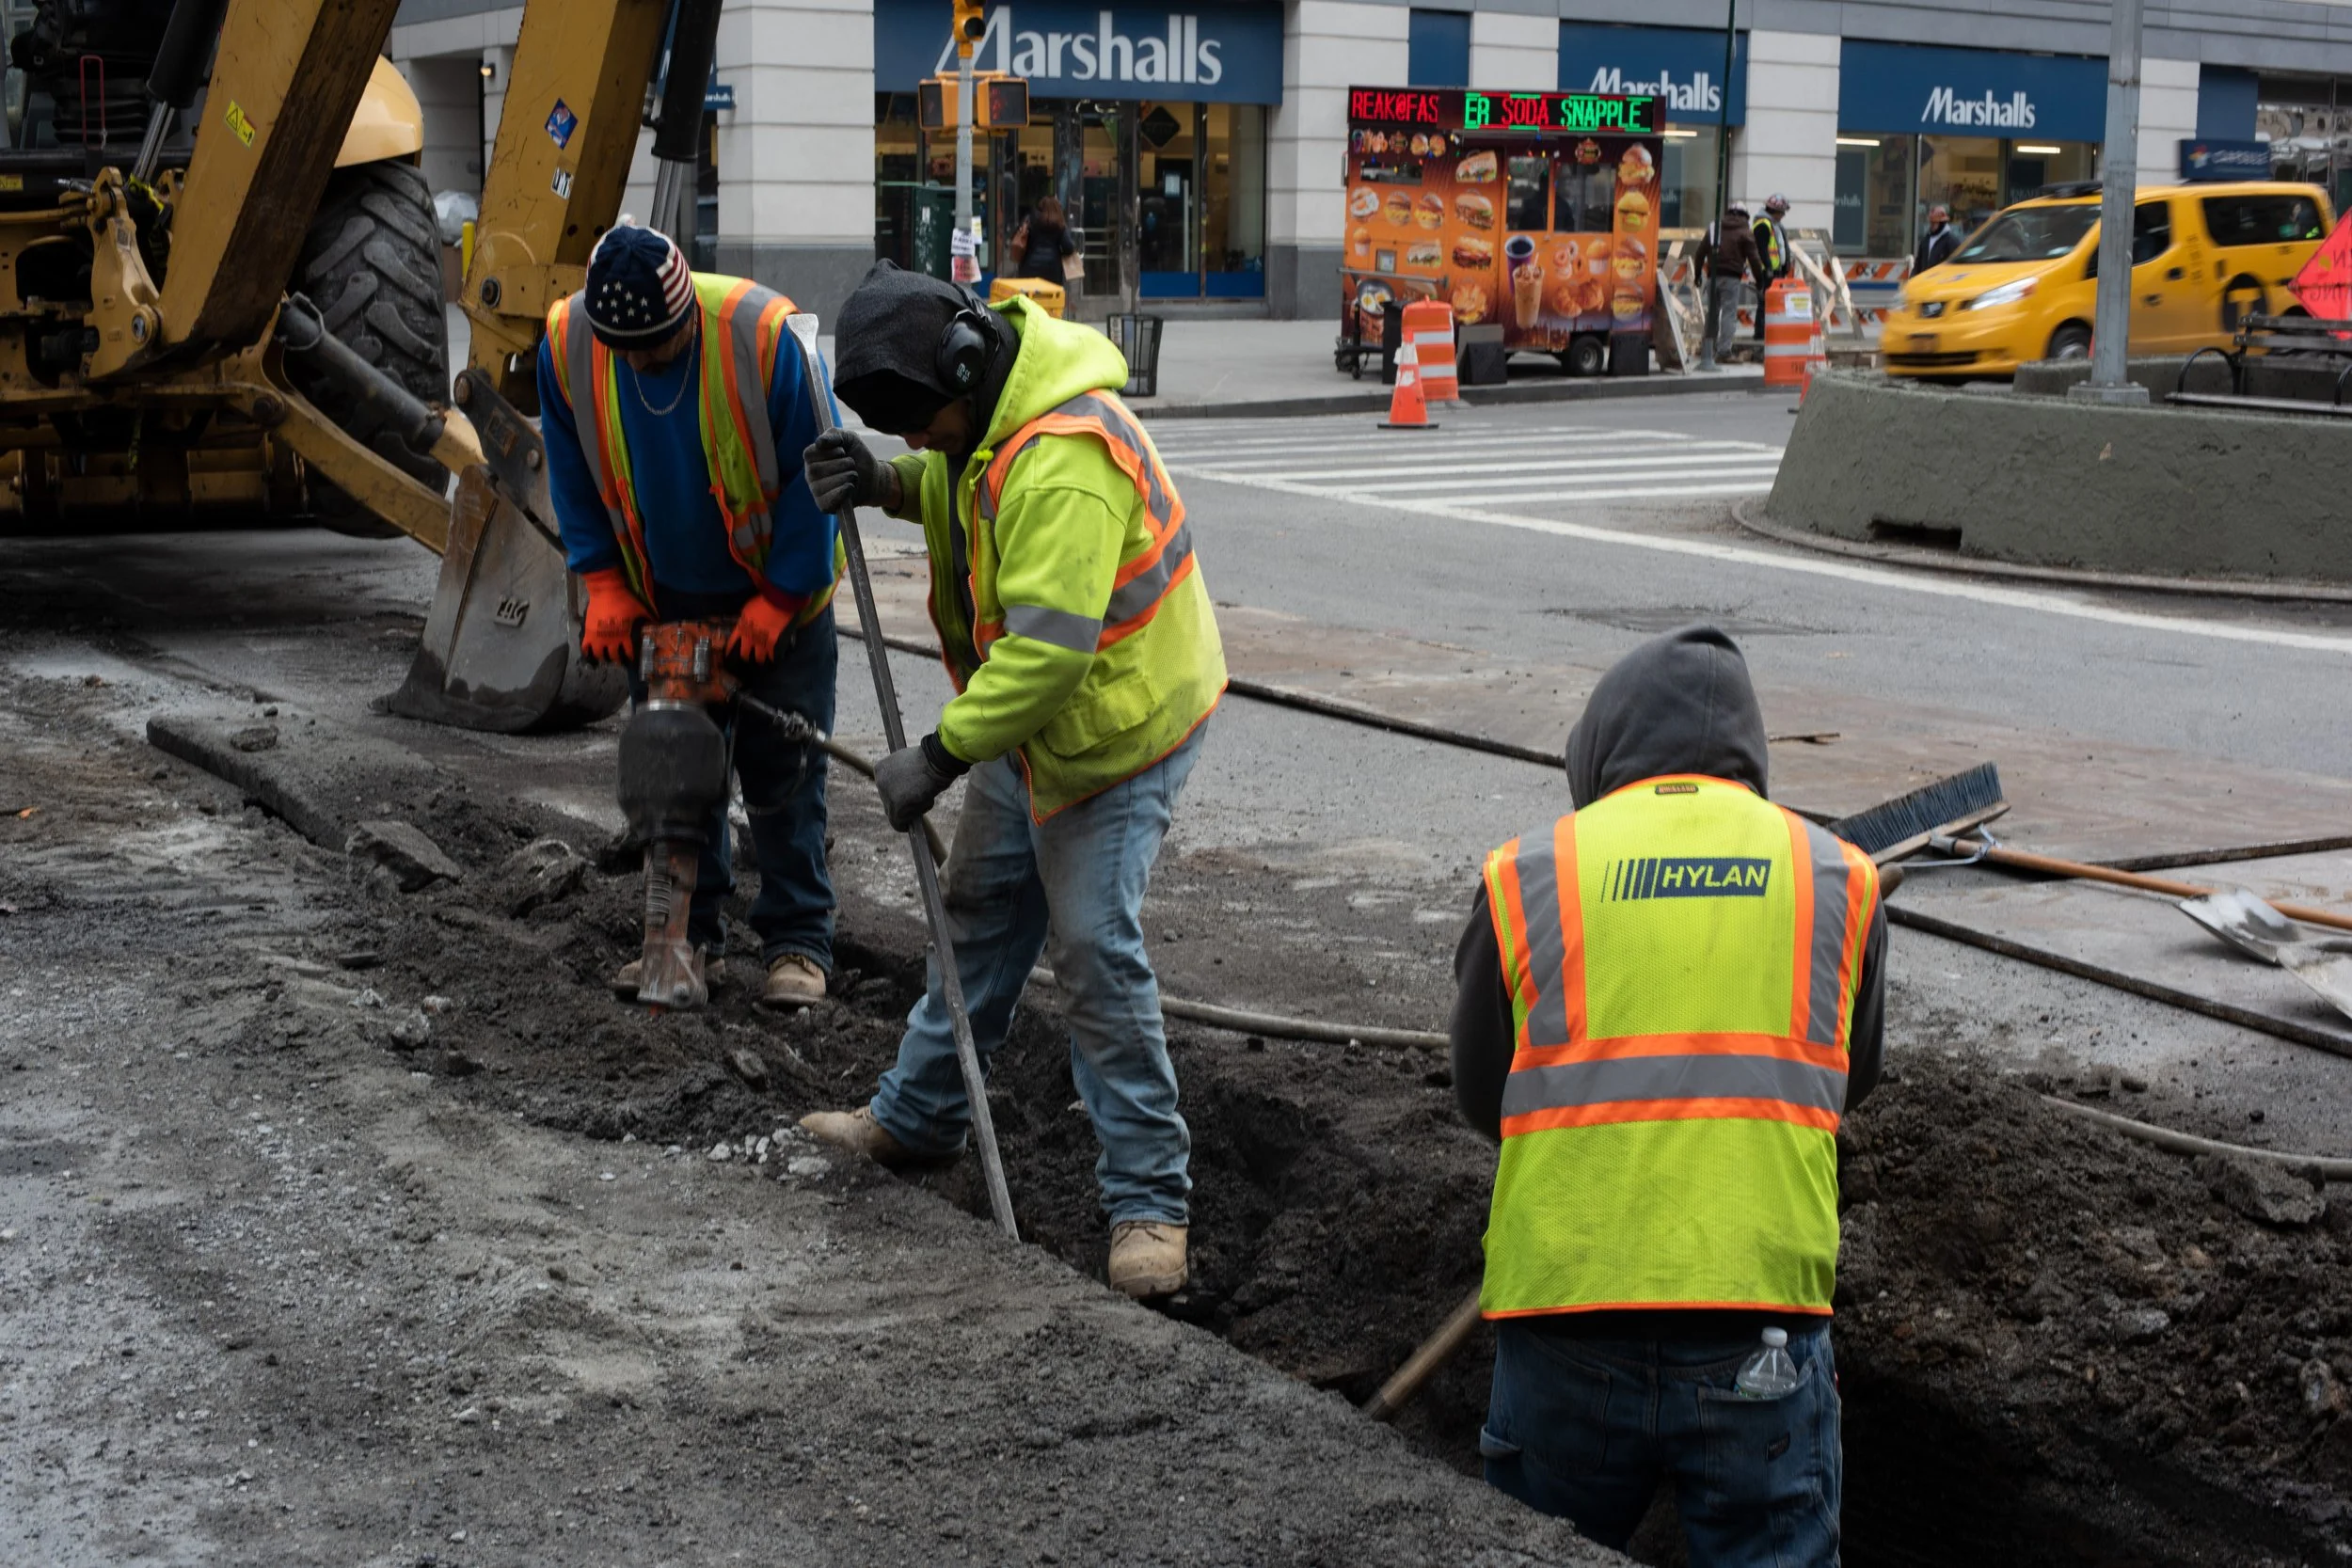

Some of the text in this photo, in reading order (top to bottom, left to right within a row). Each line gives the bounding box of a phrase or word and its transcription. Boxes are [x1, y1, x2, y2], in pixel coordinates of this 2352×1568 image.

[934, 6, 1222, 85] Marshalls
[1502, 98, 1549, 125] SODA
[1561, 99, 1642, 128] SNAPPLE
[1921, 86, 2035, 129] Marshalls
[1661, 864, 1766, 888] HYLAN
